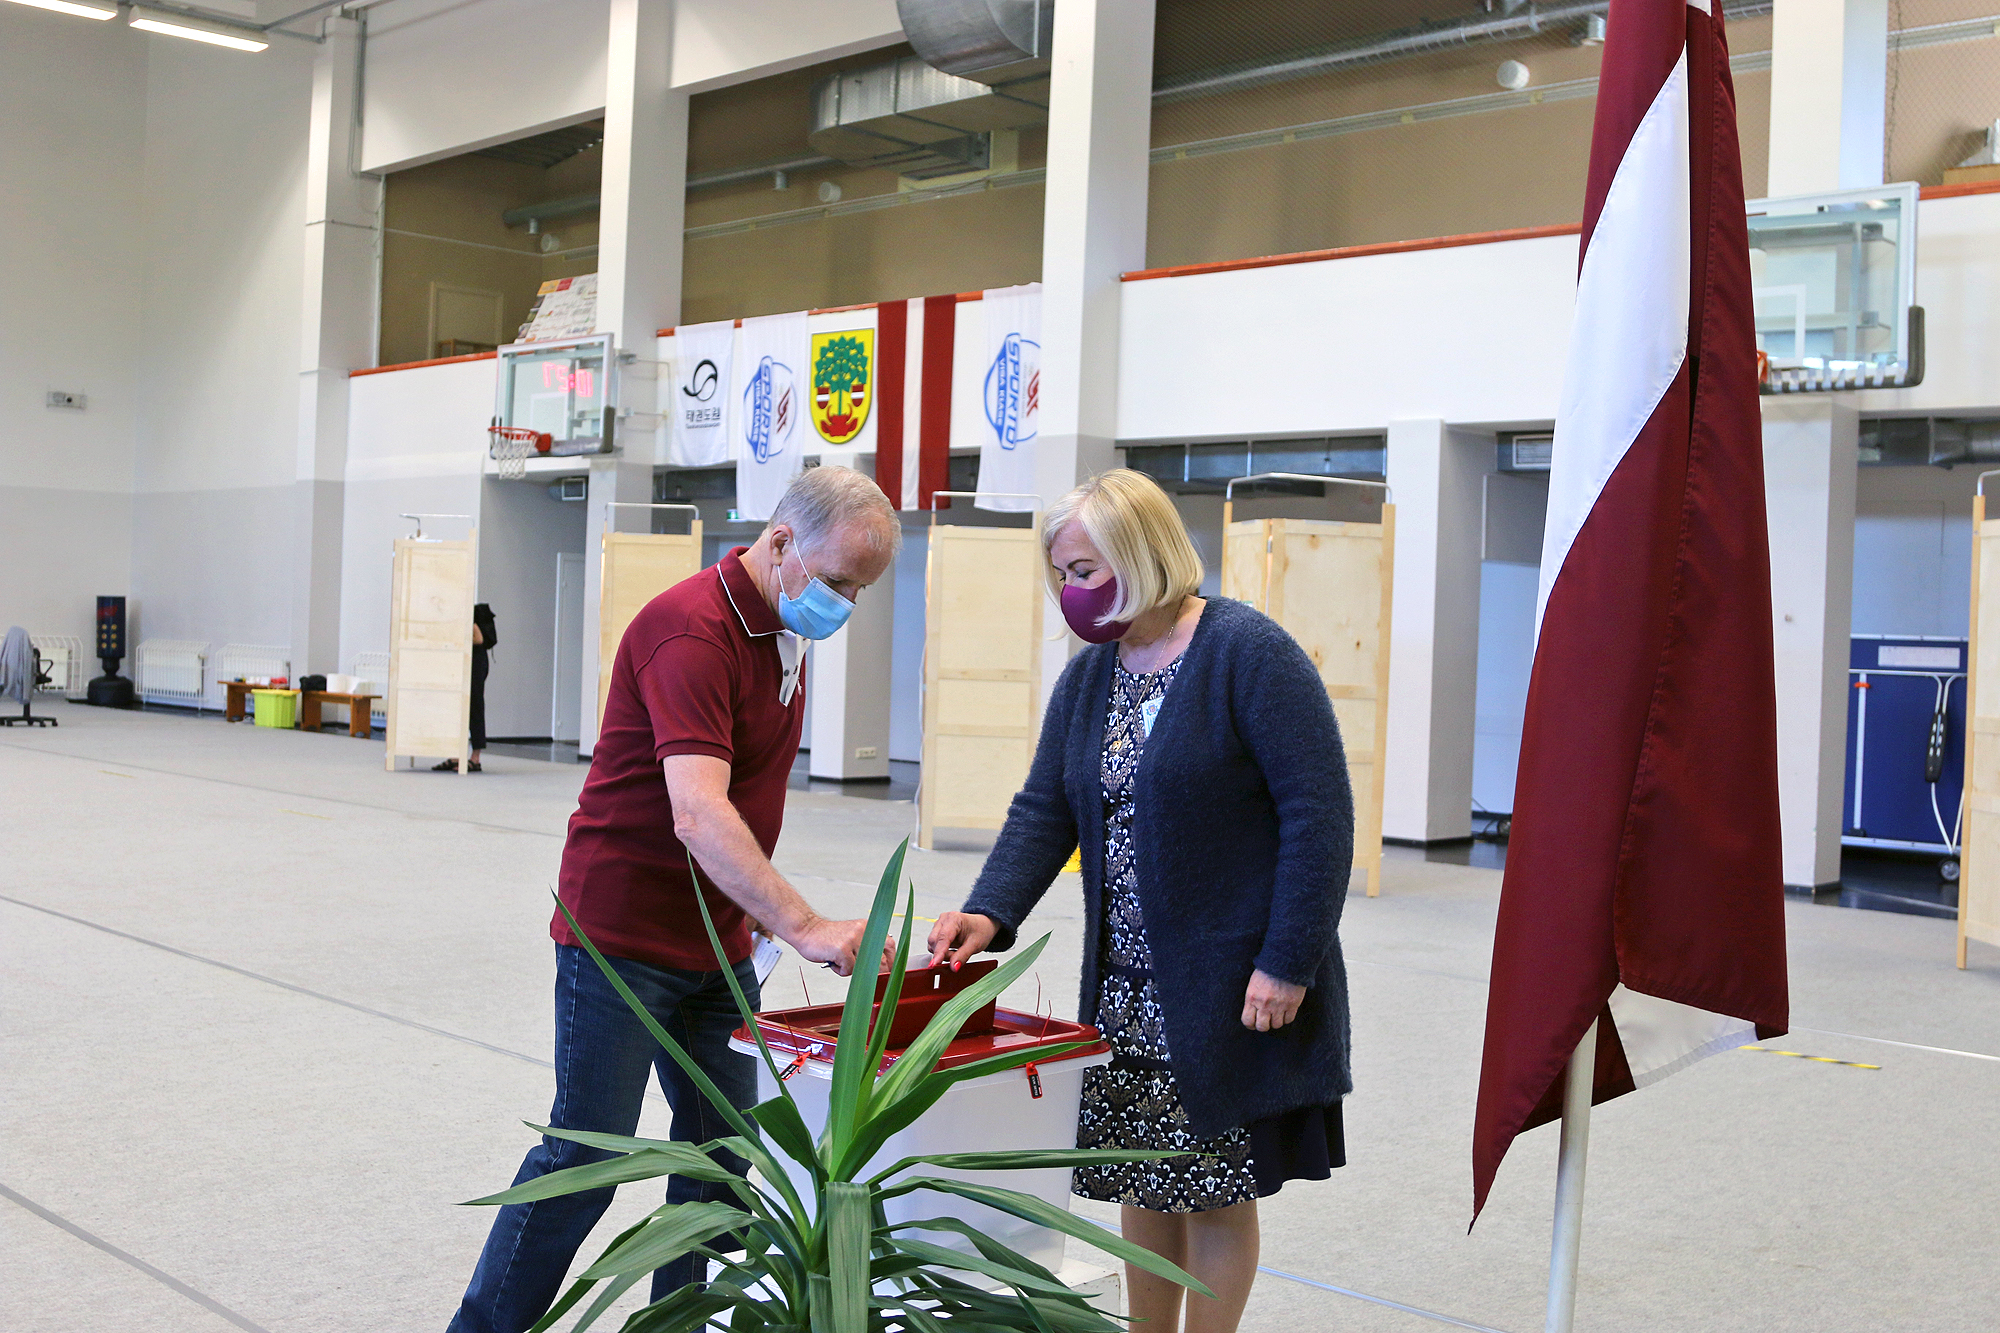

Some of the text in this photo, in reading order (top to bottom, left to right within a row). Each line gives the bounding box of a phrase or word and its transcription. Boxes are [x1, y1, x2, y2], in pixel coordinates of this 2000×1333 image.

[686, 407, 721, 422] 태권도원
[760, 364, 771, 459] SPORTO
[1006, 341, 1019, 444] SPORTO
